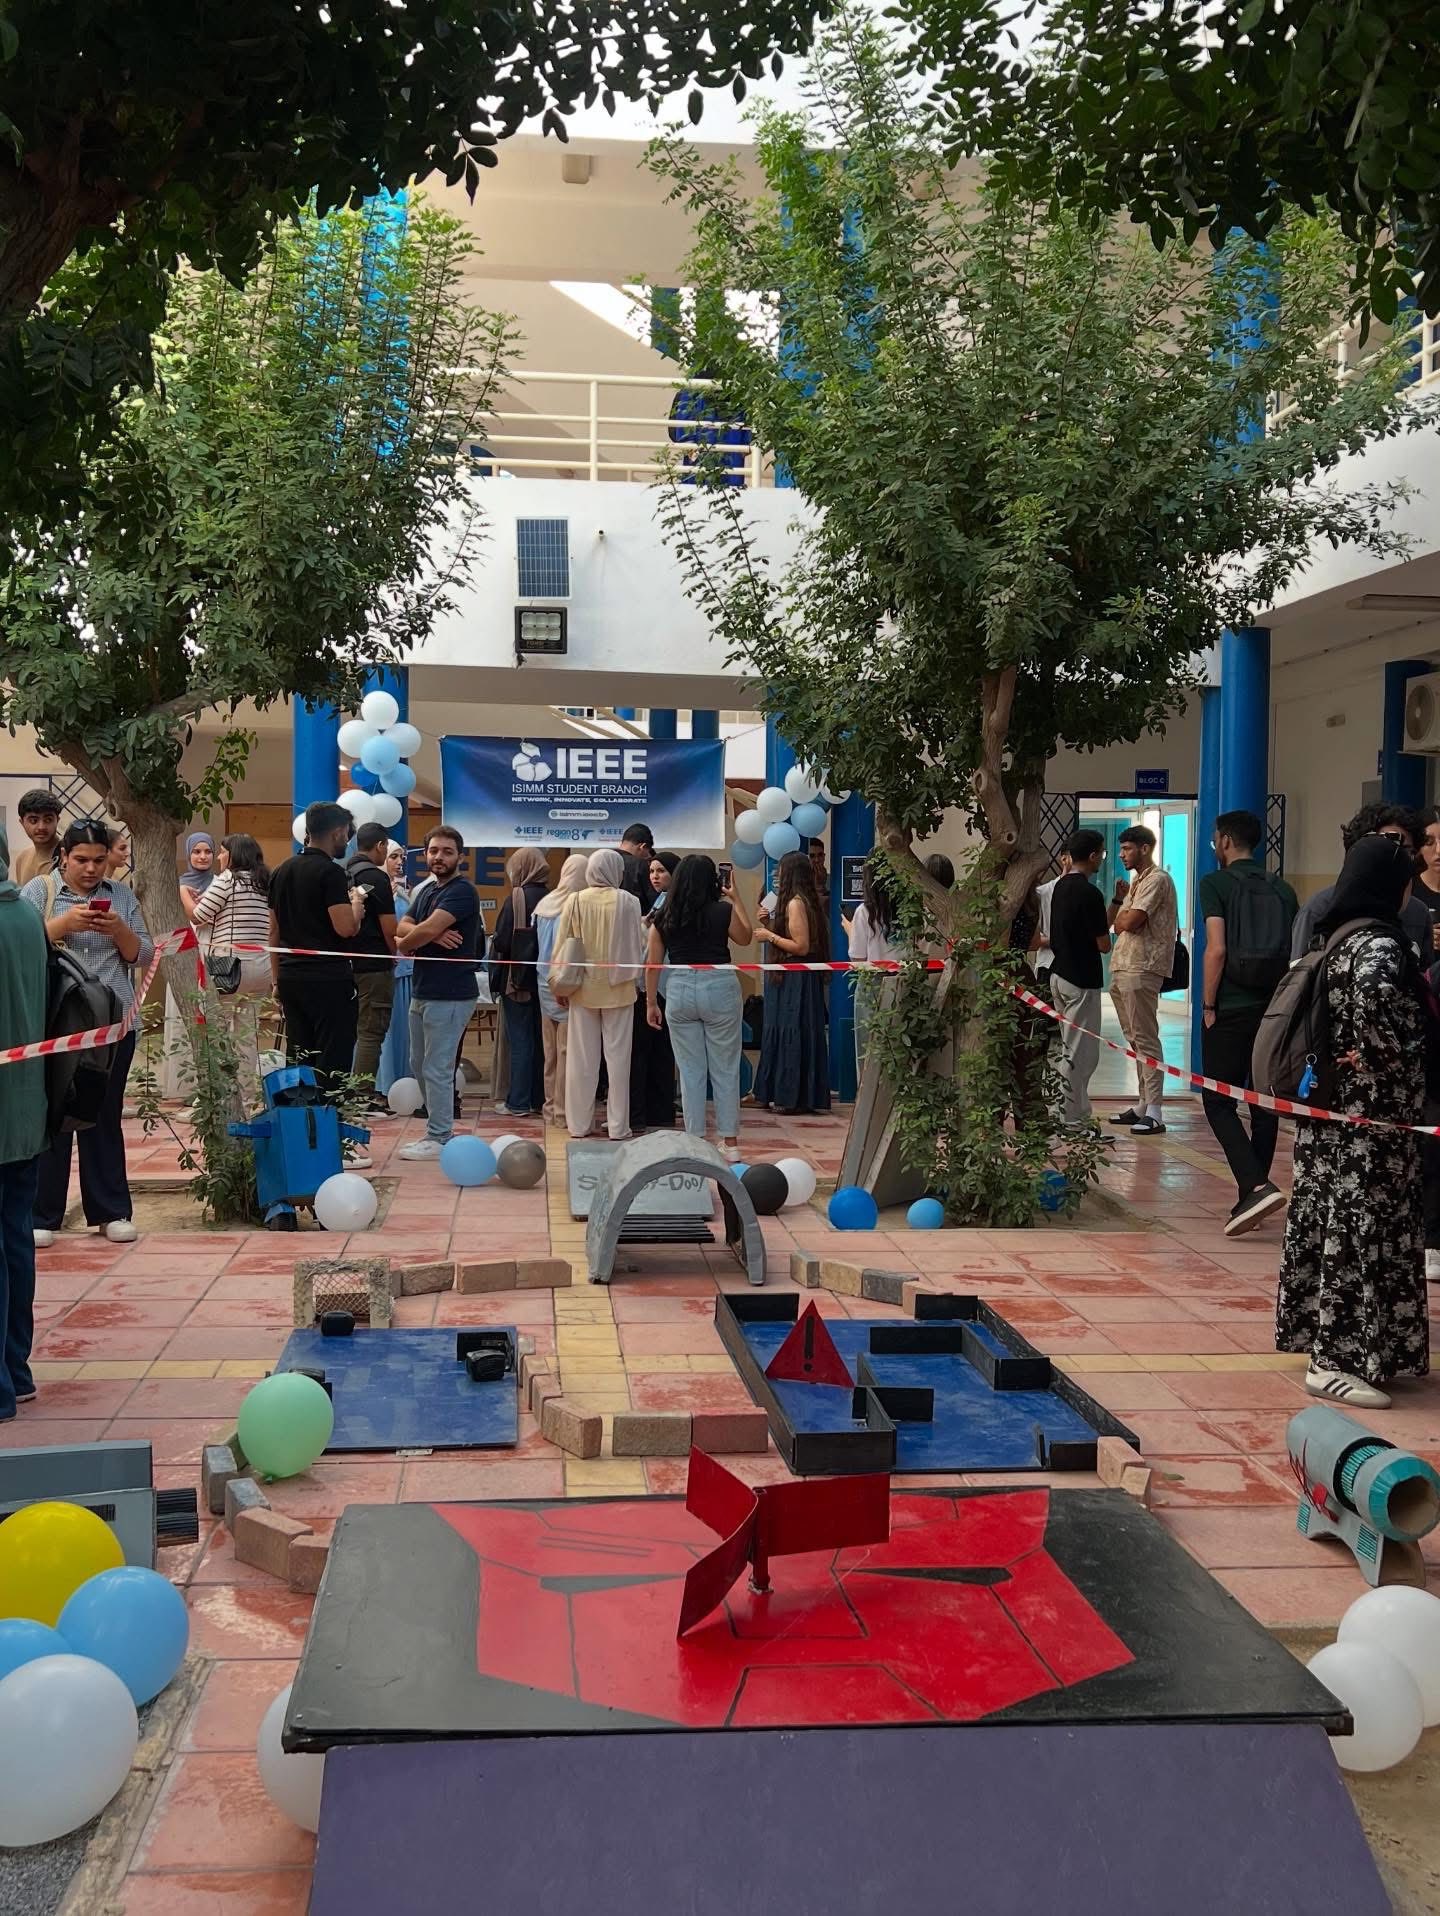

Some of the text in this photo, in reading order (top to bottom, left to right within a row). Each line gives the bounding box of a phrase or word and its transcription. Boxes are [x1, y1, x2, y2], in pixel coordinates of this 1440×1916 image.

[557, 748, 647, 780] IEEE
[512, 784, 647, 794] ISIMM STUDENT BRANCH
[523, 826, 543, 835] IEEE
[546, 828, 572, 839] region
[571, 828, 580, 841] 8
